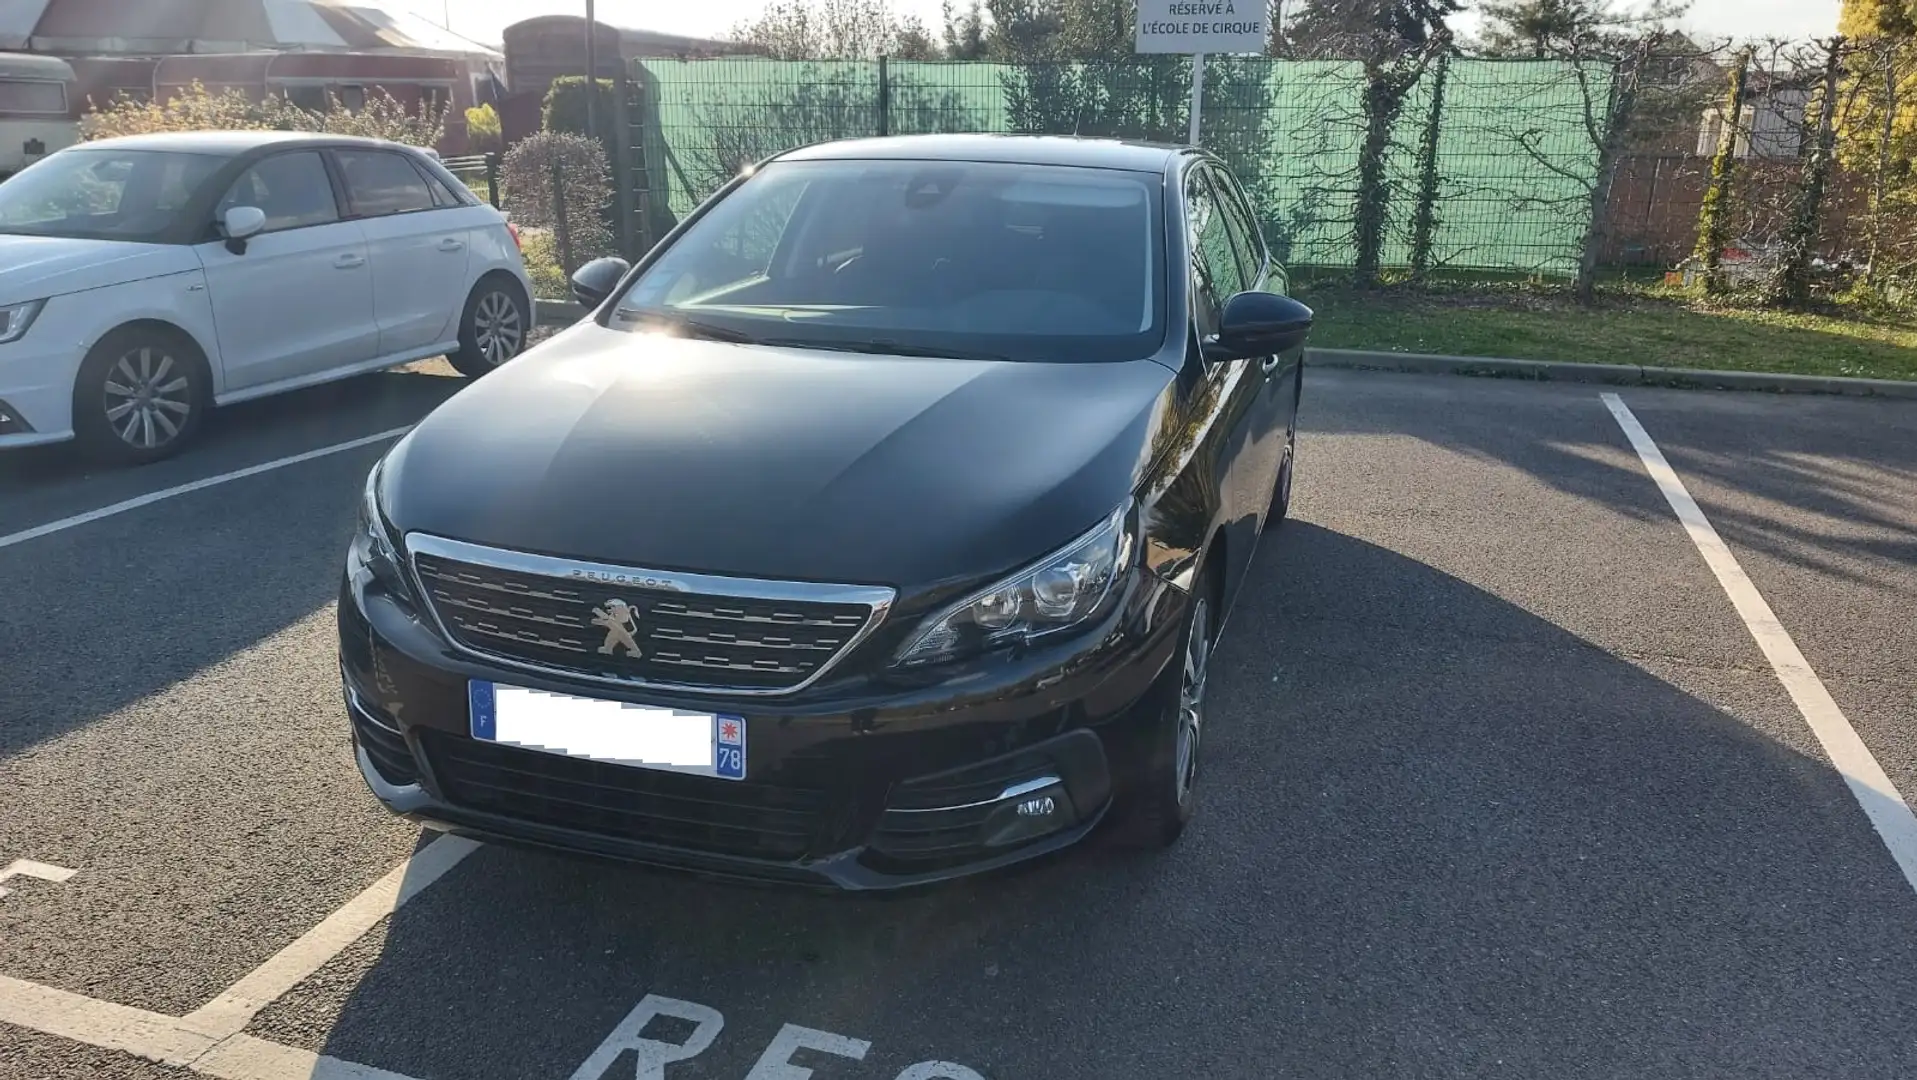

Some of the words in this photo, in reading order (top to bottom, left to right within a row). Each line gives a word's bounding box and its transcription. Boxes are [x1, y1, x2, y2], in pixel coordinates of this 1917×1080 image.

[1169, 0, 1223, 15] RÉSERVÉ
[1226, 0, 1235, 15] À
[1142, 21, 1188, 34] L'ÉCOLE
[1192, 22, 1209, 34] DE
[1212, 22, 1260, 35] CIRQUE
[573, 569, 672, 587] PEUGEOT
[480, 715, 487, 727] F
[719, 747, 741, 770] 78
